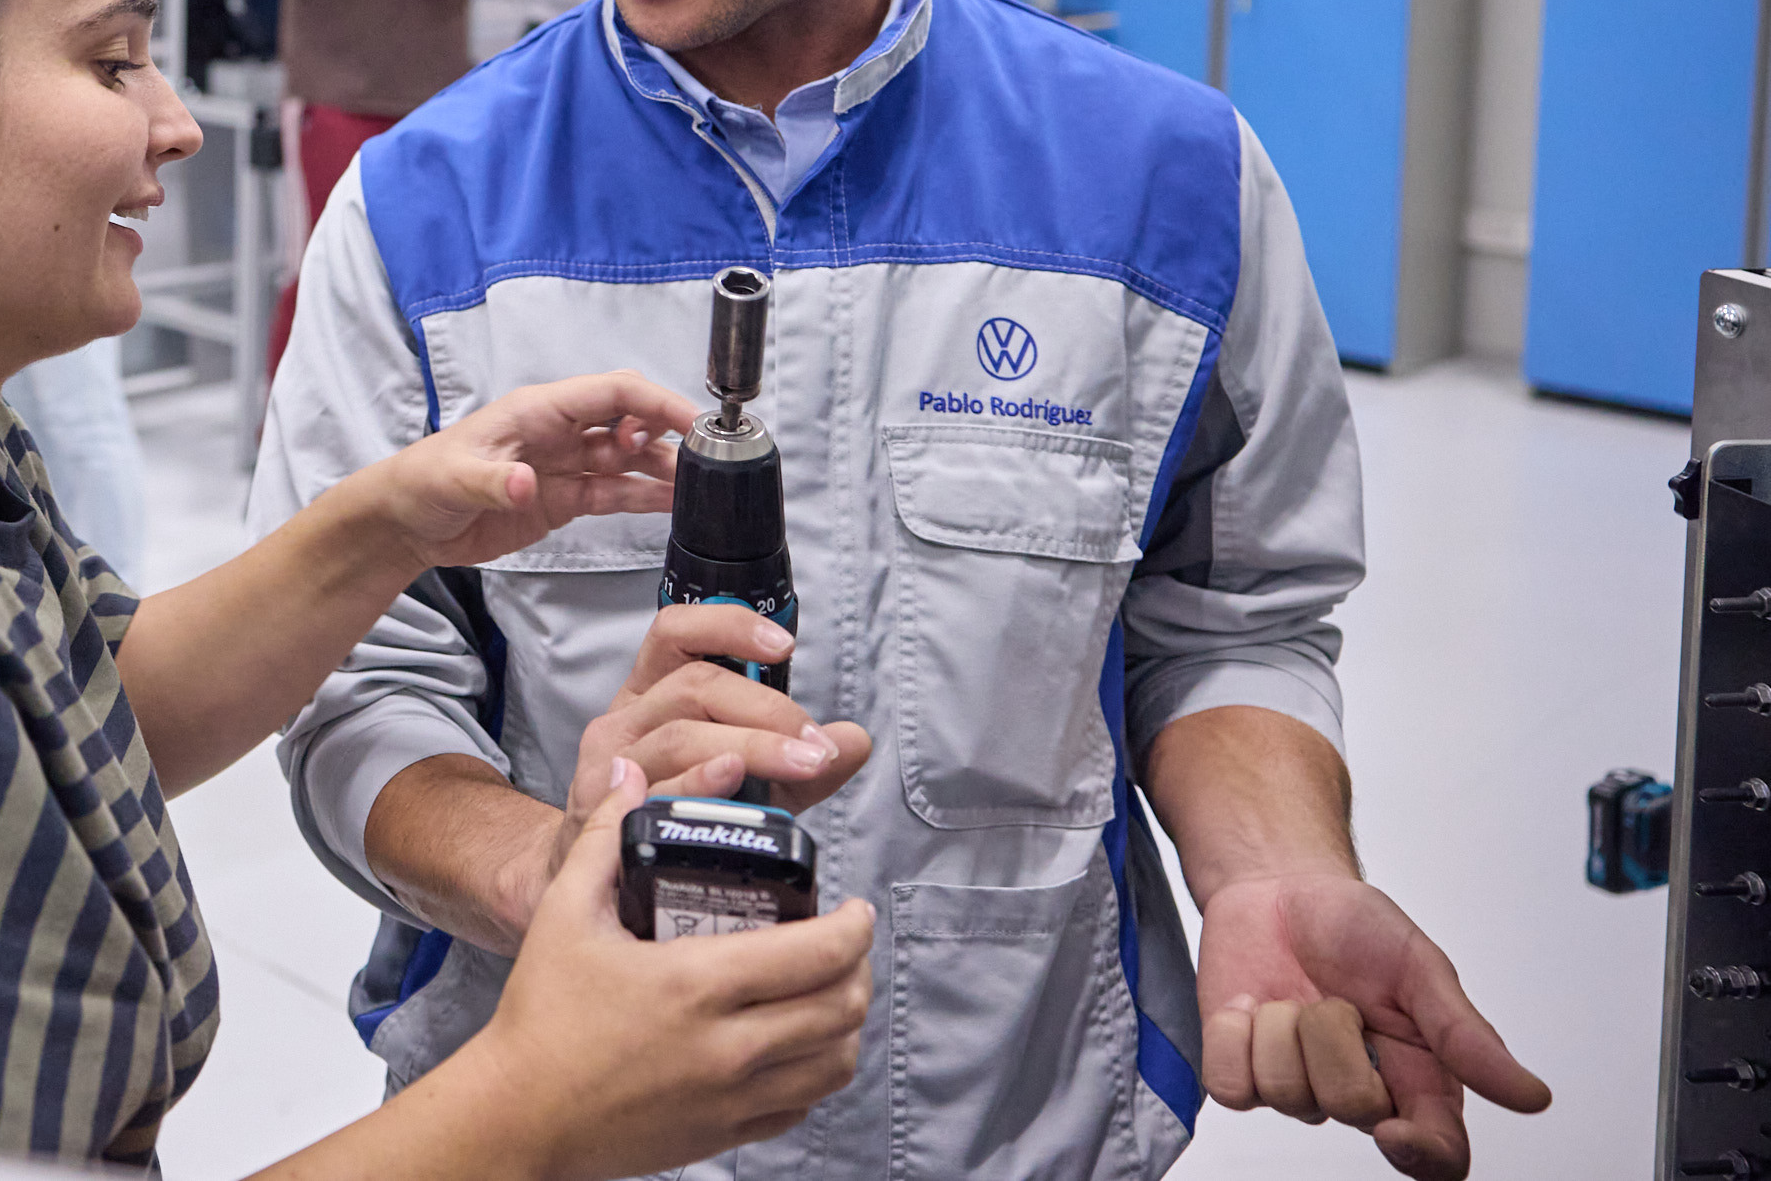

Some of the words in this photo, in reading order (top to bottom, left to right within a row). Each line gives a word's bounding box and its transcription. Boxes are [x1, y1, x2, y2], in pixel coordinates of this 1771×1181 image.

[919, 391, 984, 415] Pablo
[990, 396, 1094, 426] Rodríguez
[756, 597, 776, 615] 20
